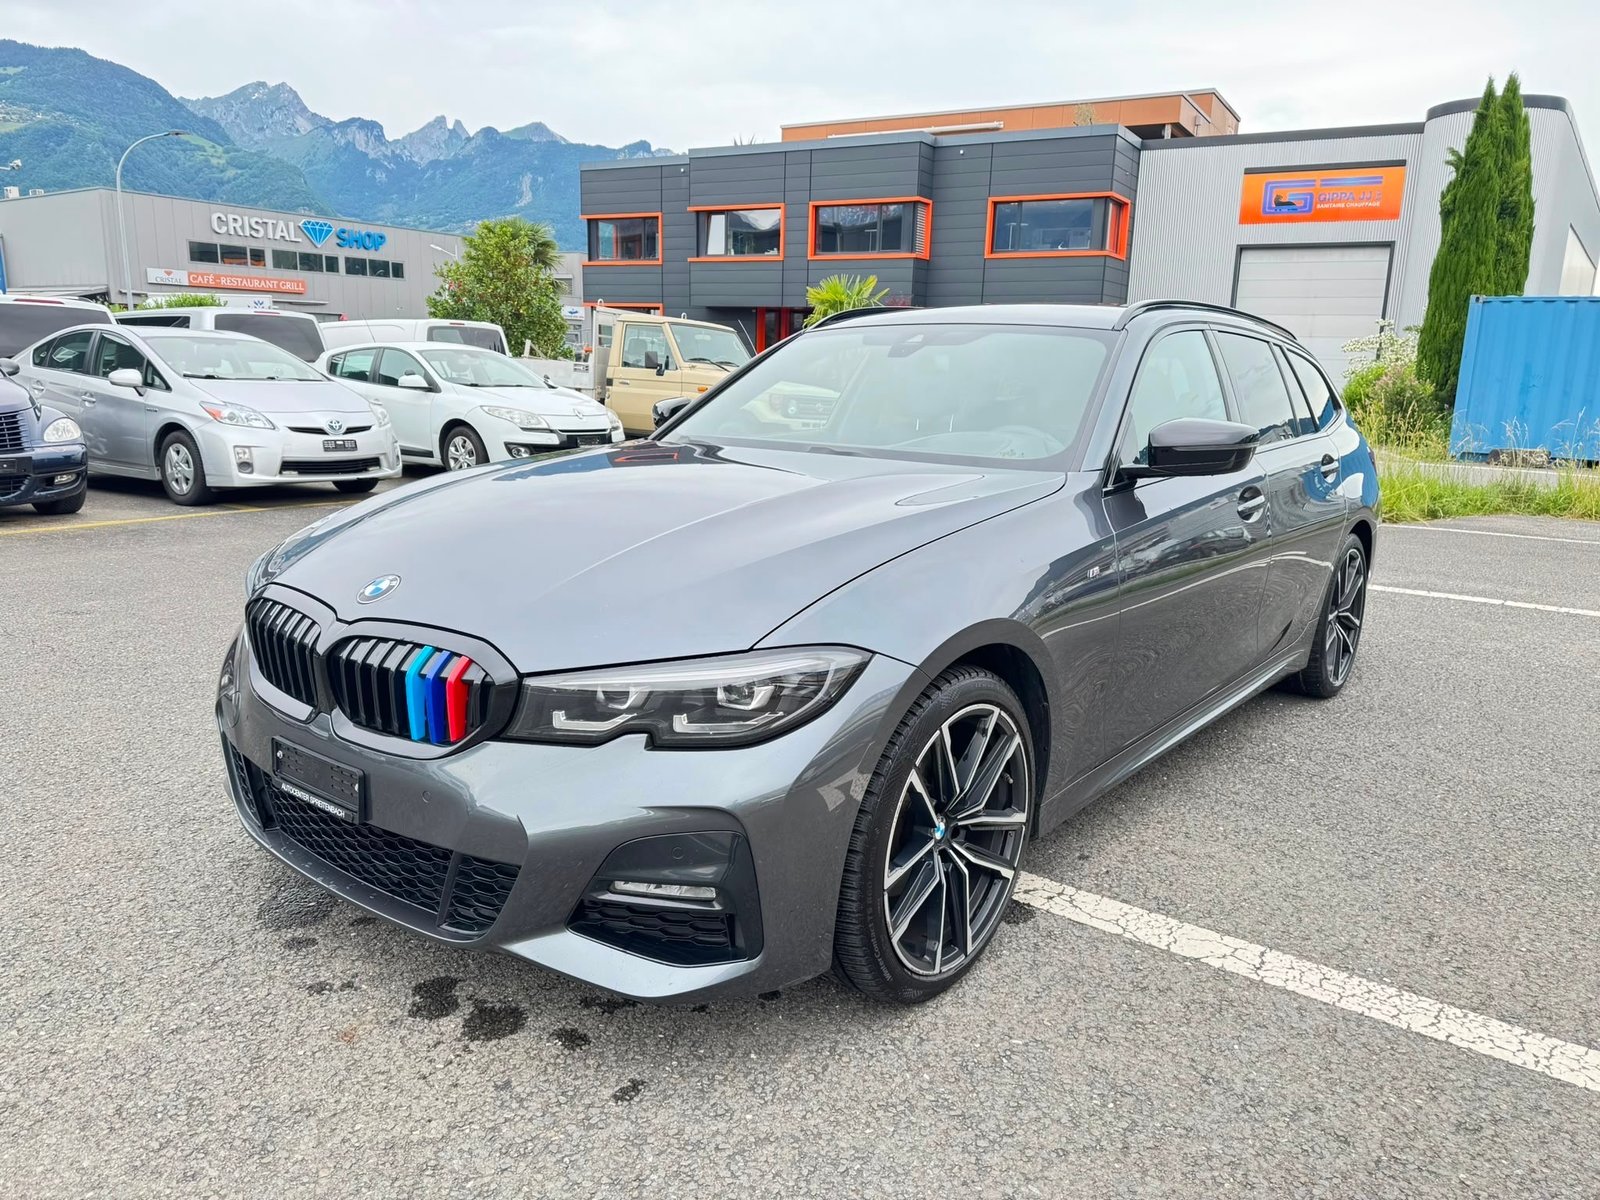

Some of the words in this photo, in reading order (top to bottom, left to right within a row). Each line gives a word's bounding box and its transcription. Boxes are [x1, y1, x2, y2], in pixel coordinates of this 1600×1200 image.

[211, 212, 302, 243] CRISTAL
[336, 227, 386, 251] SHOP
[154, 276, 182, 284] CRISTAL
[189, 273, 215, 285] CAFÉ
[220, 276, 278, 289] RESTAURANT
[279, 281, 305, 291] GRILL
[281, 783, 310, 802] AUTOCENTER
[309, 796, 345, 818] SPREITENBACH
